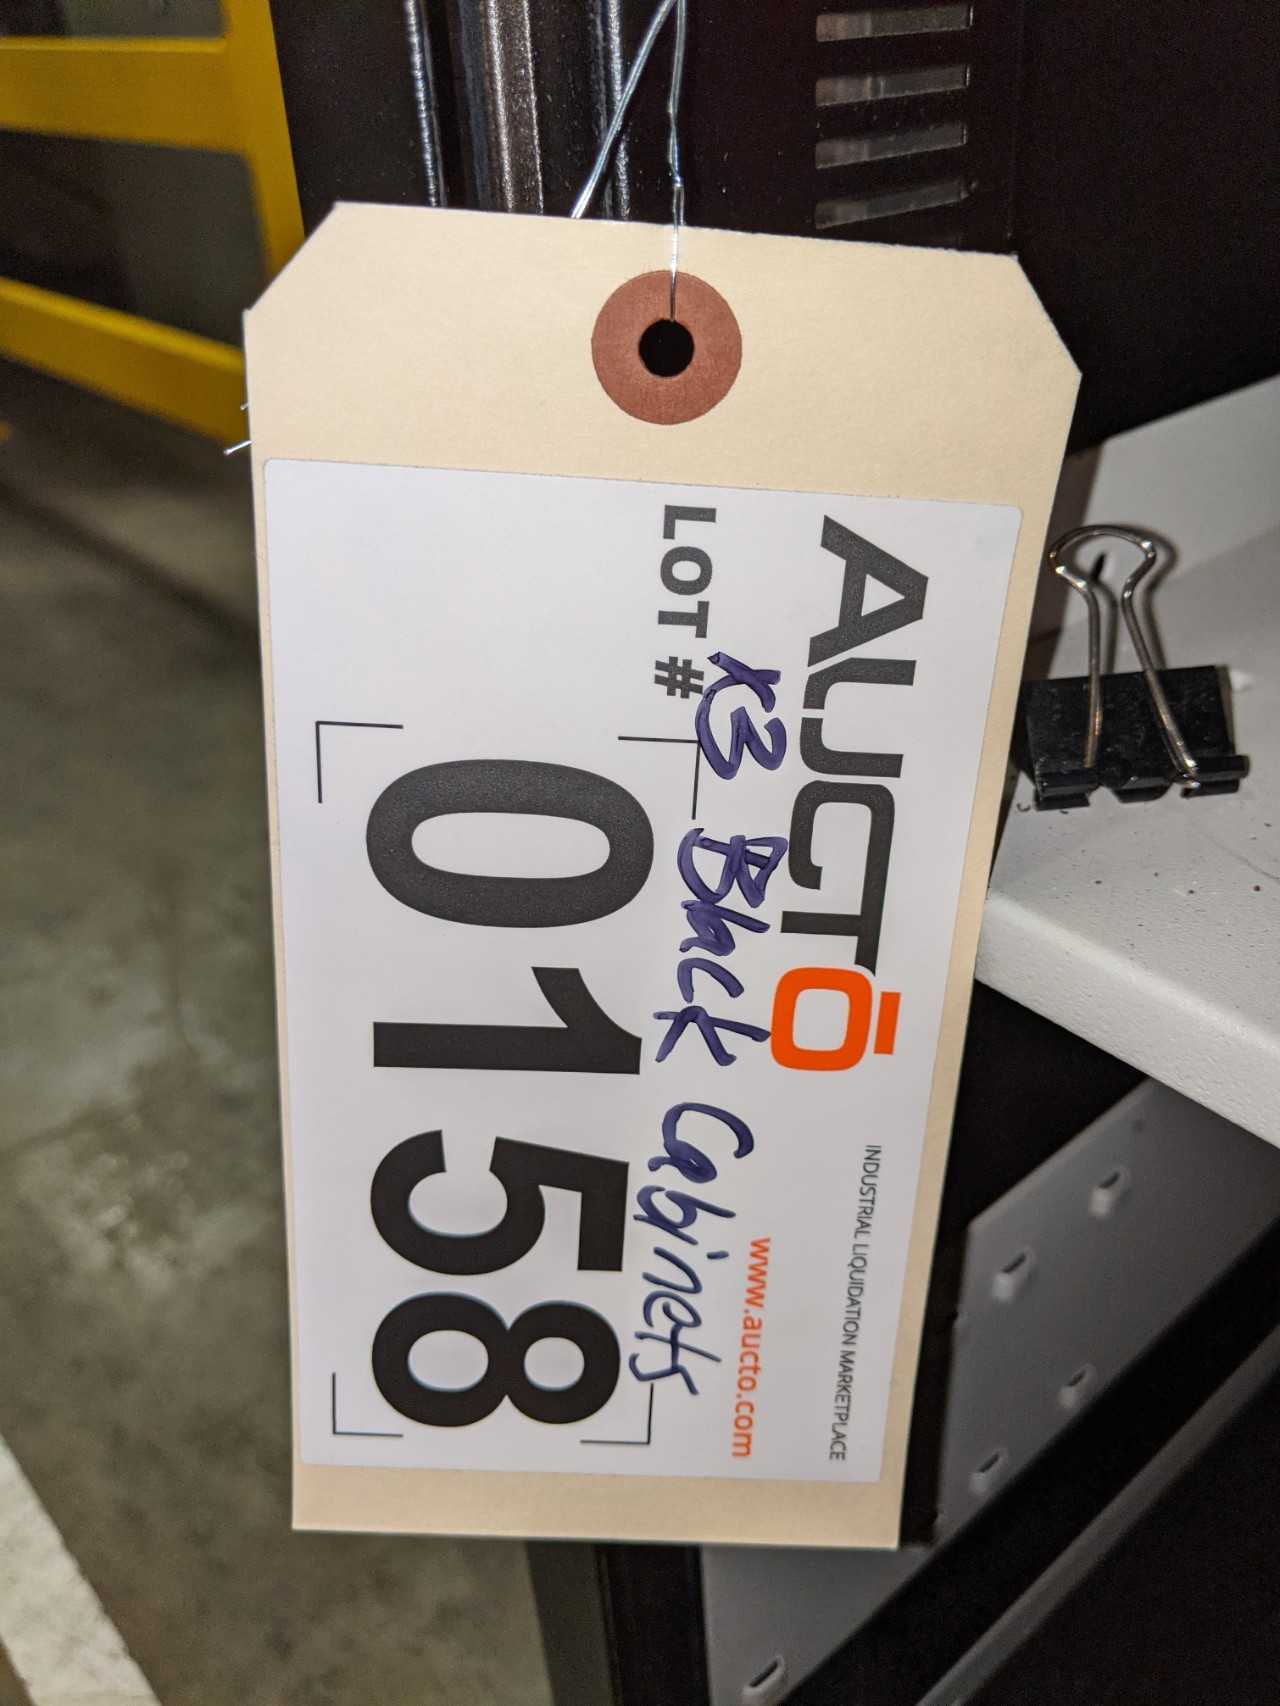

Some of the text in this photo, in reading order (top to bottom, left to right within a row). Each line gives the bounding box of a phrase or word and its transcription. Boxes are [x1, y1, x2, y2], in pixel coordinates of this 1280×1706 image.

[654, 504, 717, 699] LOT #
[653, 827, 788, 1066] Black
[366, 759, 654, 1427] 0158
[629, 1102, 754, 1395] Cabinets
[732, 1237, 771, 1458] www.aucto.com
[829, 1144, 882, 1461] INDUSTRIAL LIQUIDATION MARKETPLACE
